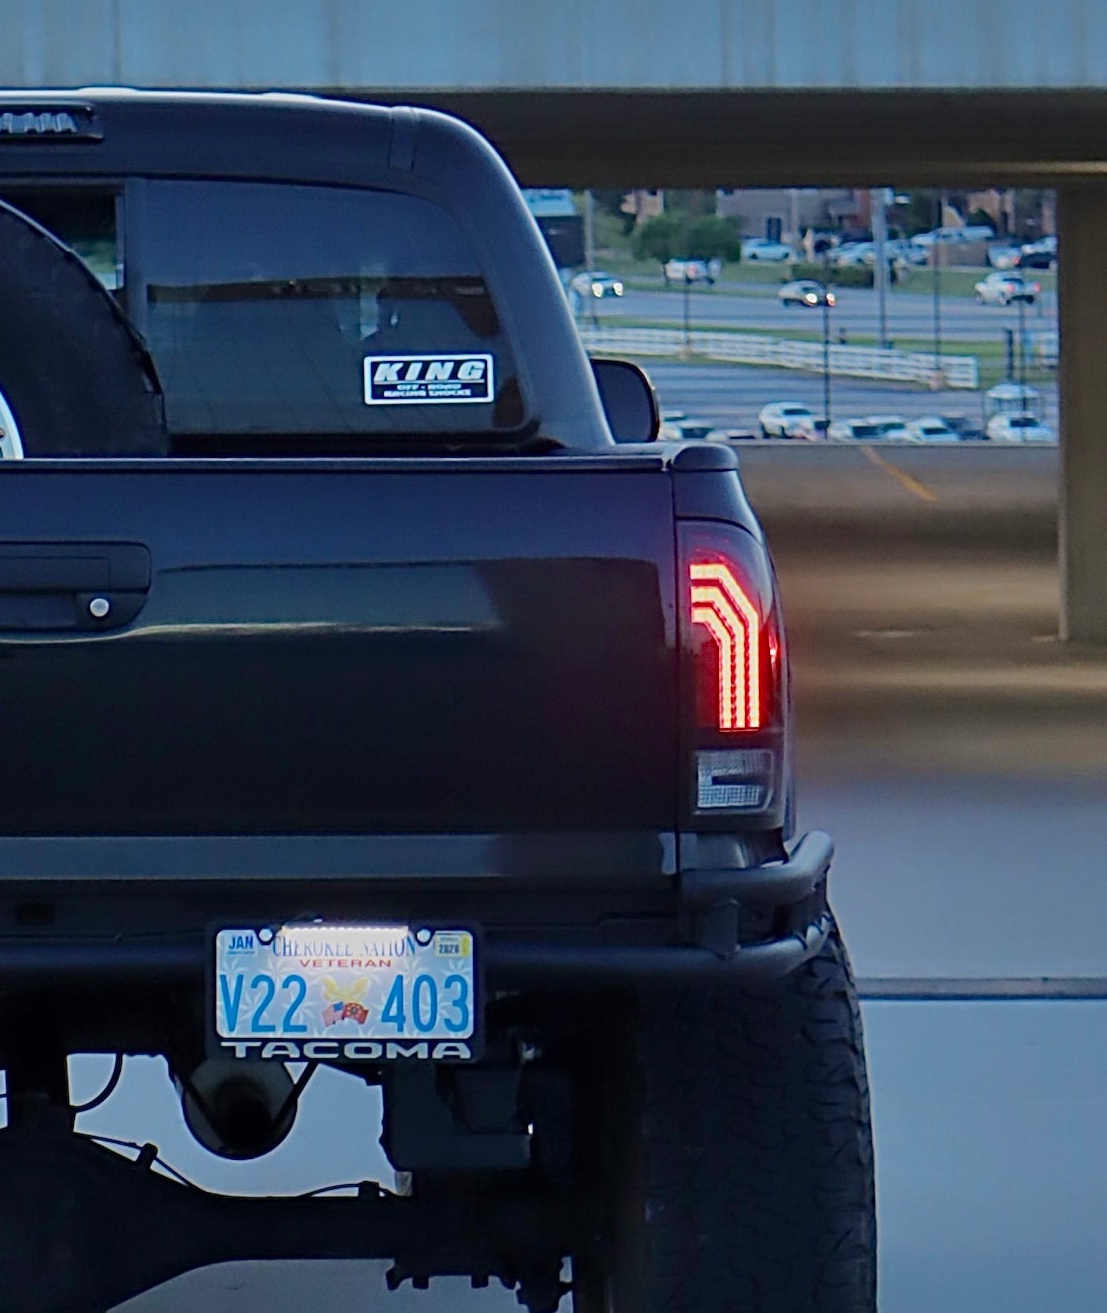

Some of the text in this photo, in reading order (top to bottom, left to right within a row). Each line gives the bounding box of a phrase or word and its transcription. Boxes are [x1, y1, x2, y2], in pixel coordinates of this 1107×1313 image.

[373, 361, 485, 381] KING
[228, 935, 253, 949] JAN
[299, 959, 392, 967] VETERAN
[220, 974, 470, 1033] V22 403
[221, 1042, 471, 1059] TACOMA
